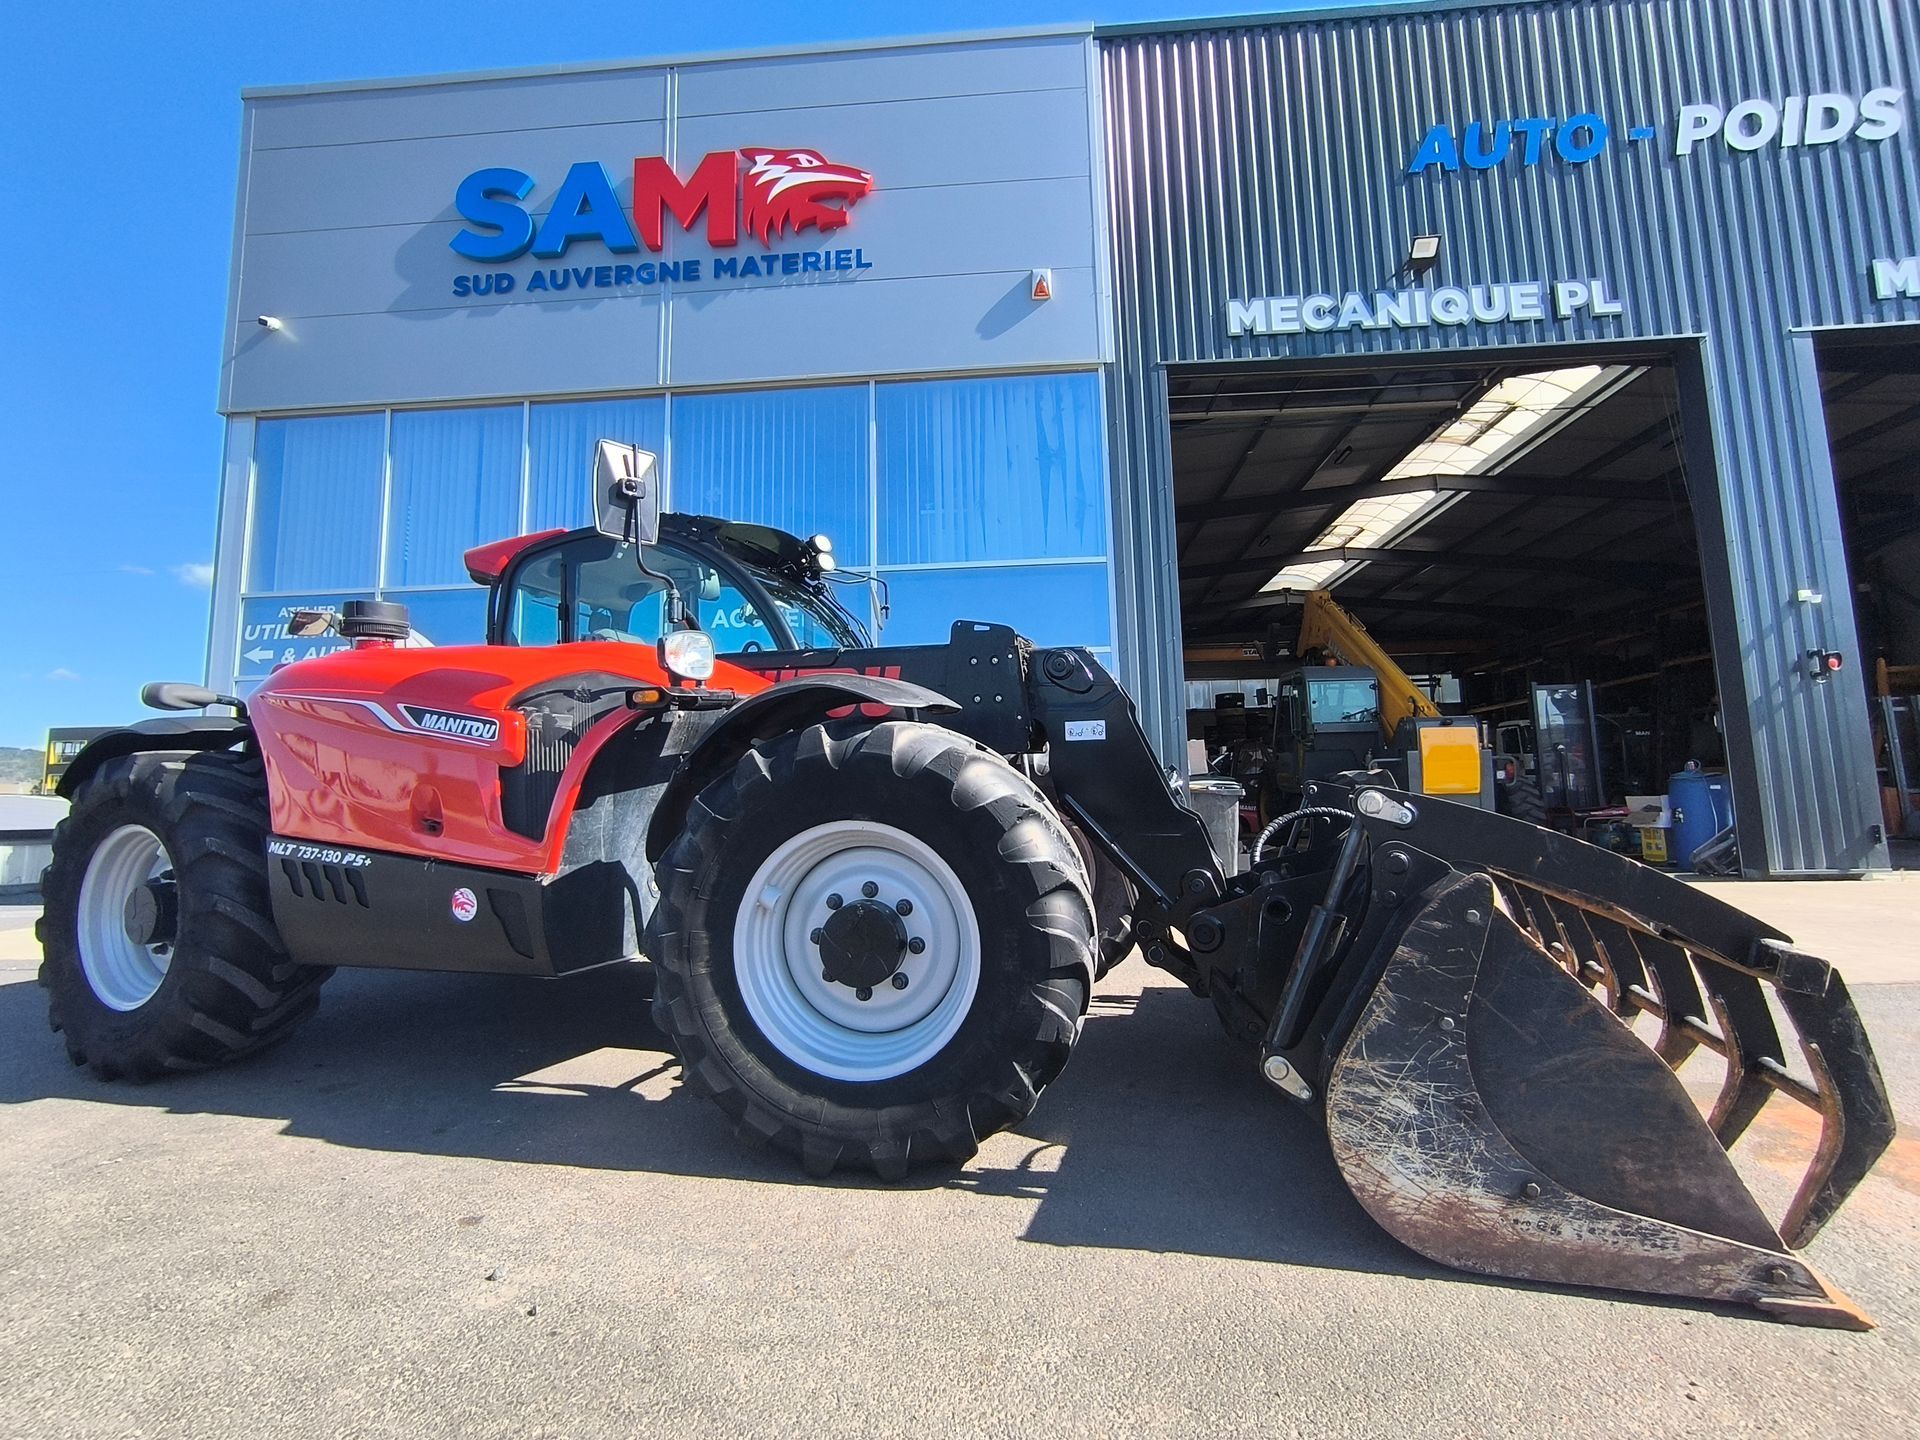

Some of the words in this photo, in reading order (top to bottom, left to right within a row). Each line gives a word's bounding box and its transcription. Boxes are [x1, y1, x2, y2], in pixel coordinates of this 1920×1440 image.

[1408, 113, 1609, 173] AUTO
[1676, 87, 1905, 155] POIDS
[449, 150, 738, 263] SAM
[452, 273, 515, 298] SUD
[526, 259, 701, 292] AUVERGNE
[713, 248, 873, 279] MATERIEL
[1227, 282, 1544, 336] MECANIQUE
[1554, 278, 1623, 319] PL
[421, 713, 497, 739] MANITOU
[268, 841, 297, 856] MLT
[297, 846, 341, 863] 737-130
[342, 853, 371, 866] PS+
